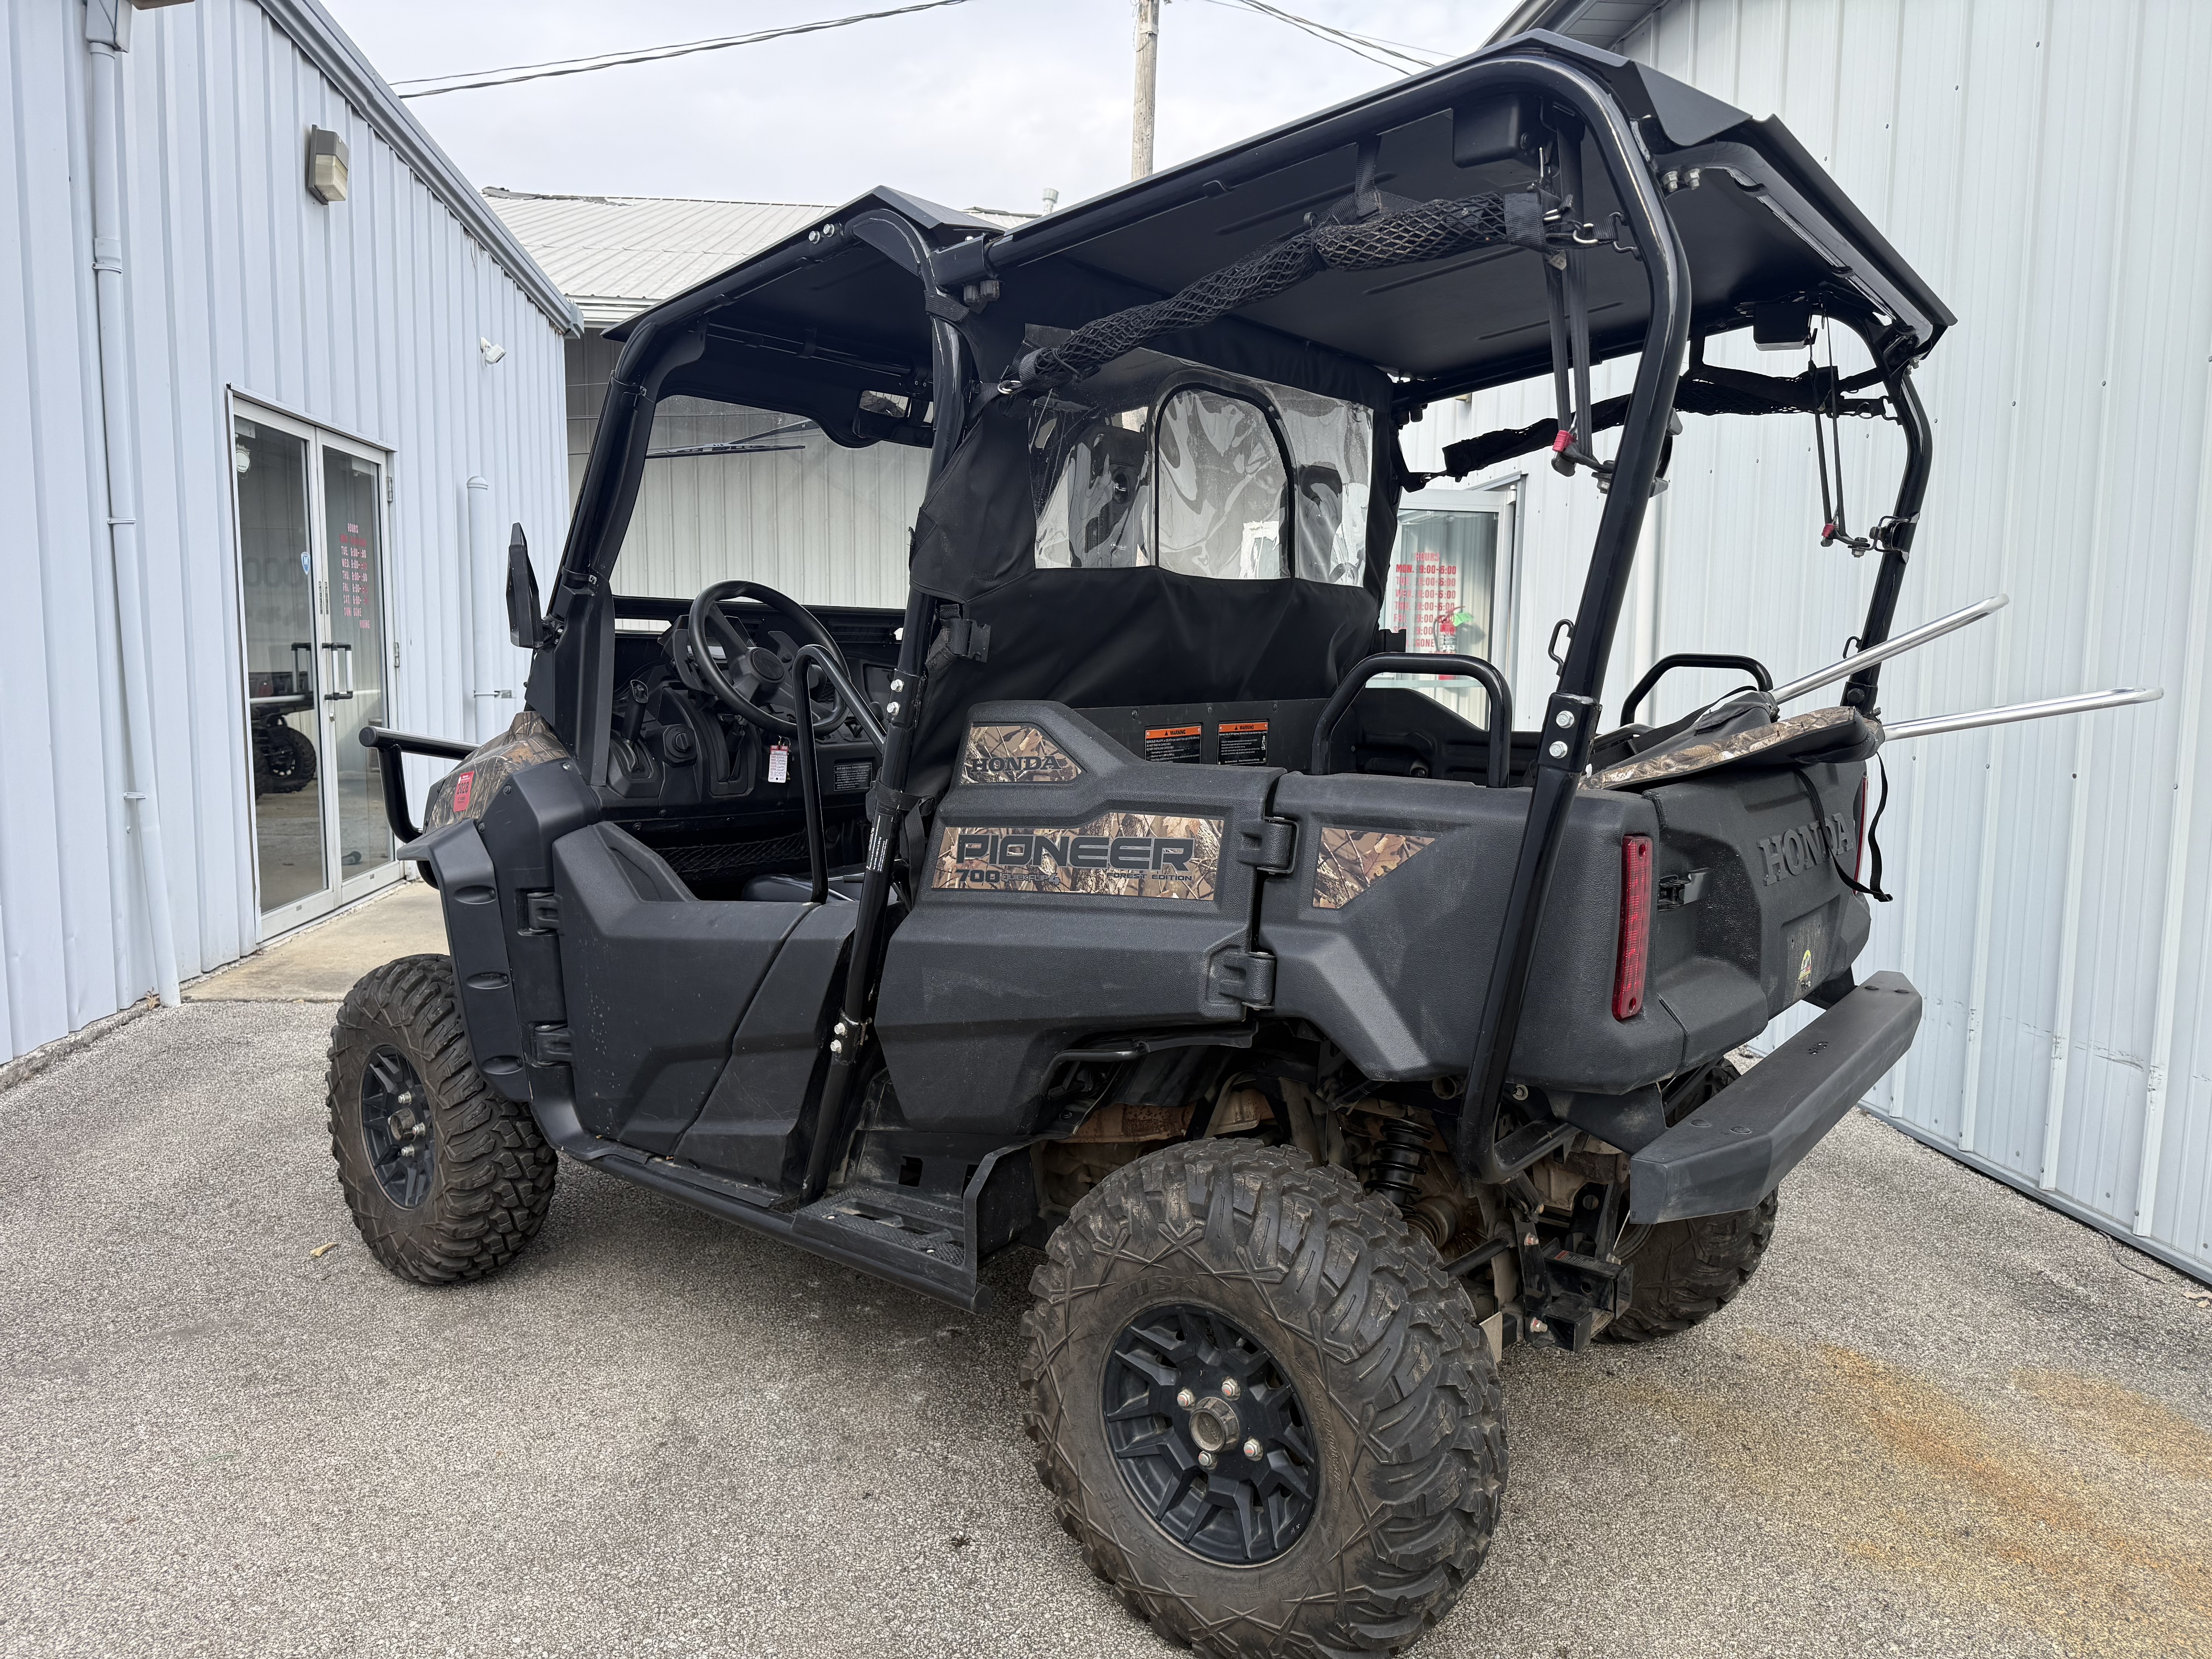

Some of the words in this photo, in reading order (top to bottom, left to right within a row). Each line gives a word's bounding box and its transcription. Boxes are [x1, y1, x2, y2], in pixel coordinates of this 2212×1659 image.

[1416, 552, 1440, 561] HOURS
[1396, 564, 1414, 573] MON.
[1419, 565, 1456, 574] 9:00-6:00
[1395, 589, 1413, 598] WED.
[1418, 590, 1456, 599] 9:00-6:00
[1415, 639, 1434, 647] GONE
[970, 755, 1062, 773] HONDA
[457, 781, 469, 794] 2028
[956, 833, 1195, 871] PIONEER
[1757, 812, 1854, 886] HONDA
[955, 869, 1000, 884] 700
[1113, 1275, 1199, 1305] TUSK
